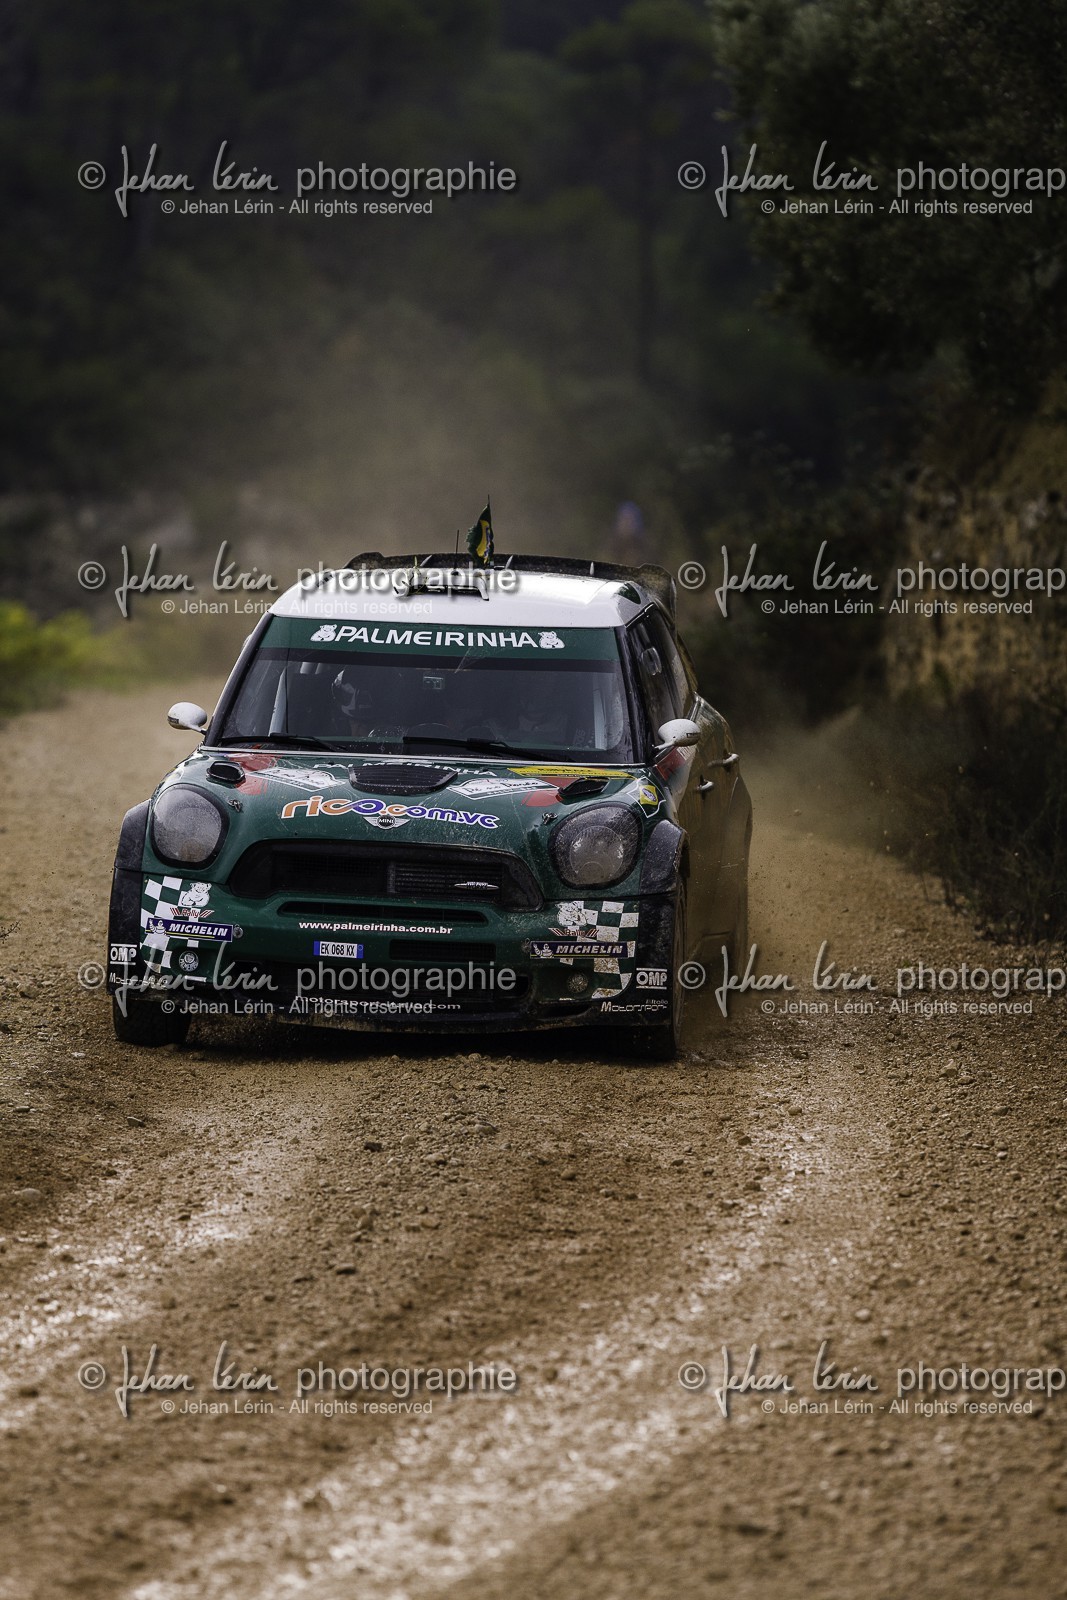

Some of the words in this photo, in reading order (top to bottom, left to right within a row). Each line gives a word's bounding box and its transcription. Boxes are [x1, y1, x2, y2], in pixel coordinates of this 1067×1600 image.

[335, 625, 539, 649] PALMEIRINHA
[281, 796, 501, 829] rico.com.vc
[168, 923, 229, 937] MICHELIN
[298, 921, 453, 934] www.palmeirinha.com.br
[110, 946, 137, 962] OMP
[320, 943, 329, 955] EK
[331, 943, 345, 956] 068
[346, 944, 355, 957] KX
[555, 944, 623, 955] MICHELIN
[636, 971, 668, 986] OMP
